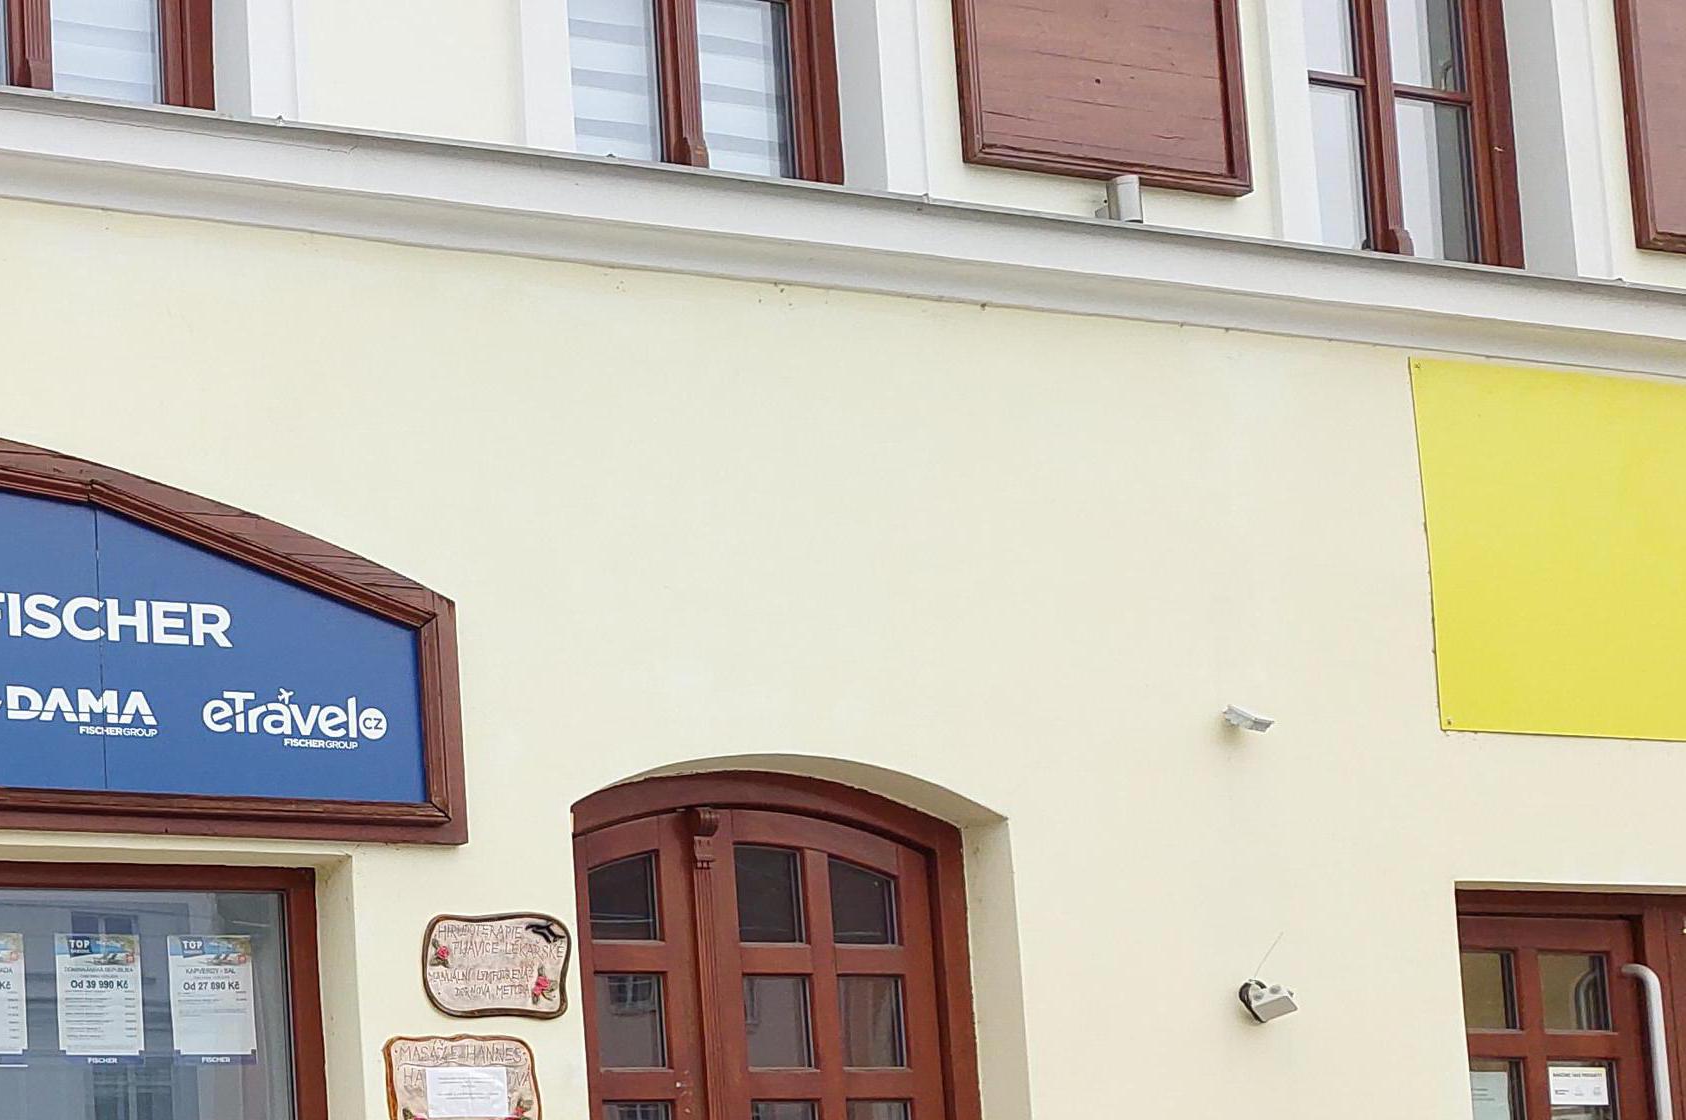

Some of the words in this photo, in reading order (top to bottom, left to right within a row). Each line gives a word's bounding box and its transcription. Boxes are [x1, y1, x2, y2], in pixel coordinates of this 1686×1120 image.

[68, 940, 90, 949] TOP
[181, 941, 203, 949] TOP
[452, 940, 500, 958] PIJAVICE
[0, 981, 11, 990] Kč
[70, 980, 84, 989] Od
[86, 980, 97, 989] 39
[117, 980, 129, 989] Kč
[183, 981, 196, 990] Od
[198, 982, 207, 990] 27
[228, 981, 240, 990] Kč
[399, 1041, 460, 1062] MASÁŽE
[465, 1042, 524, 1063] HANNES
